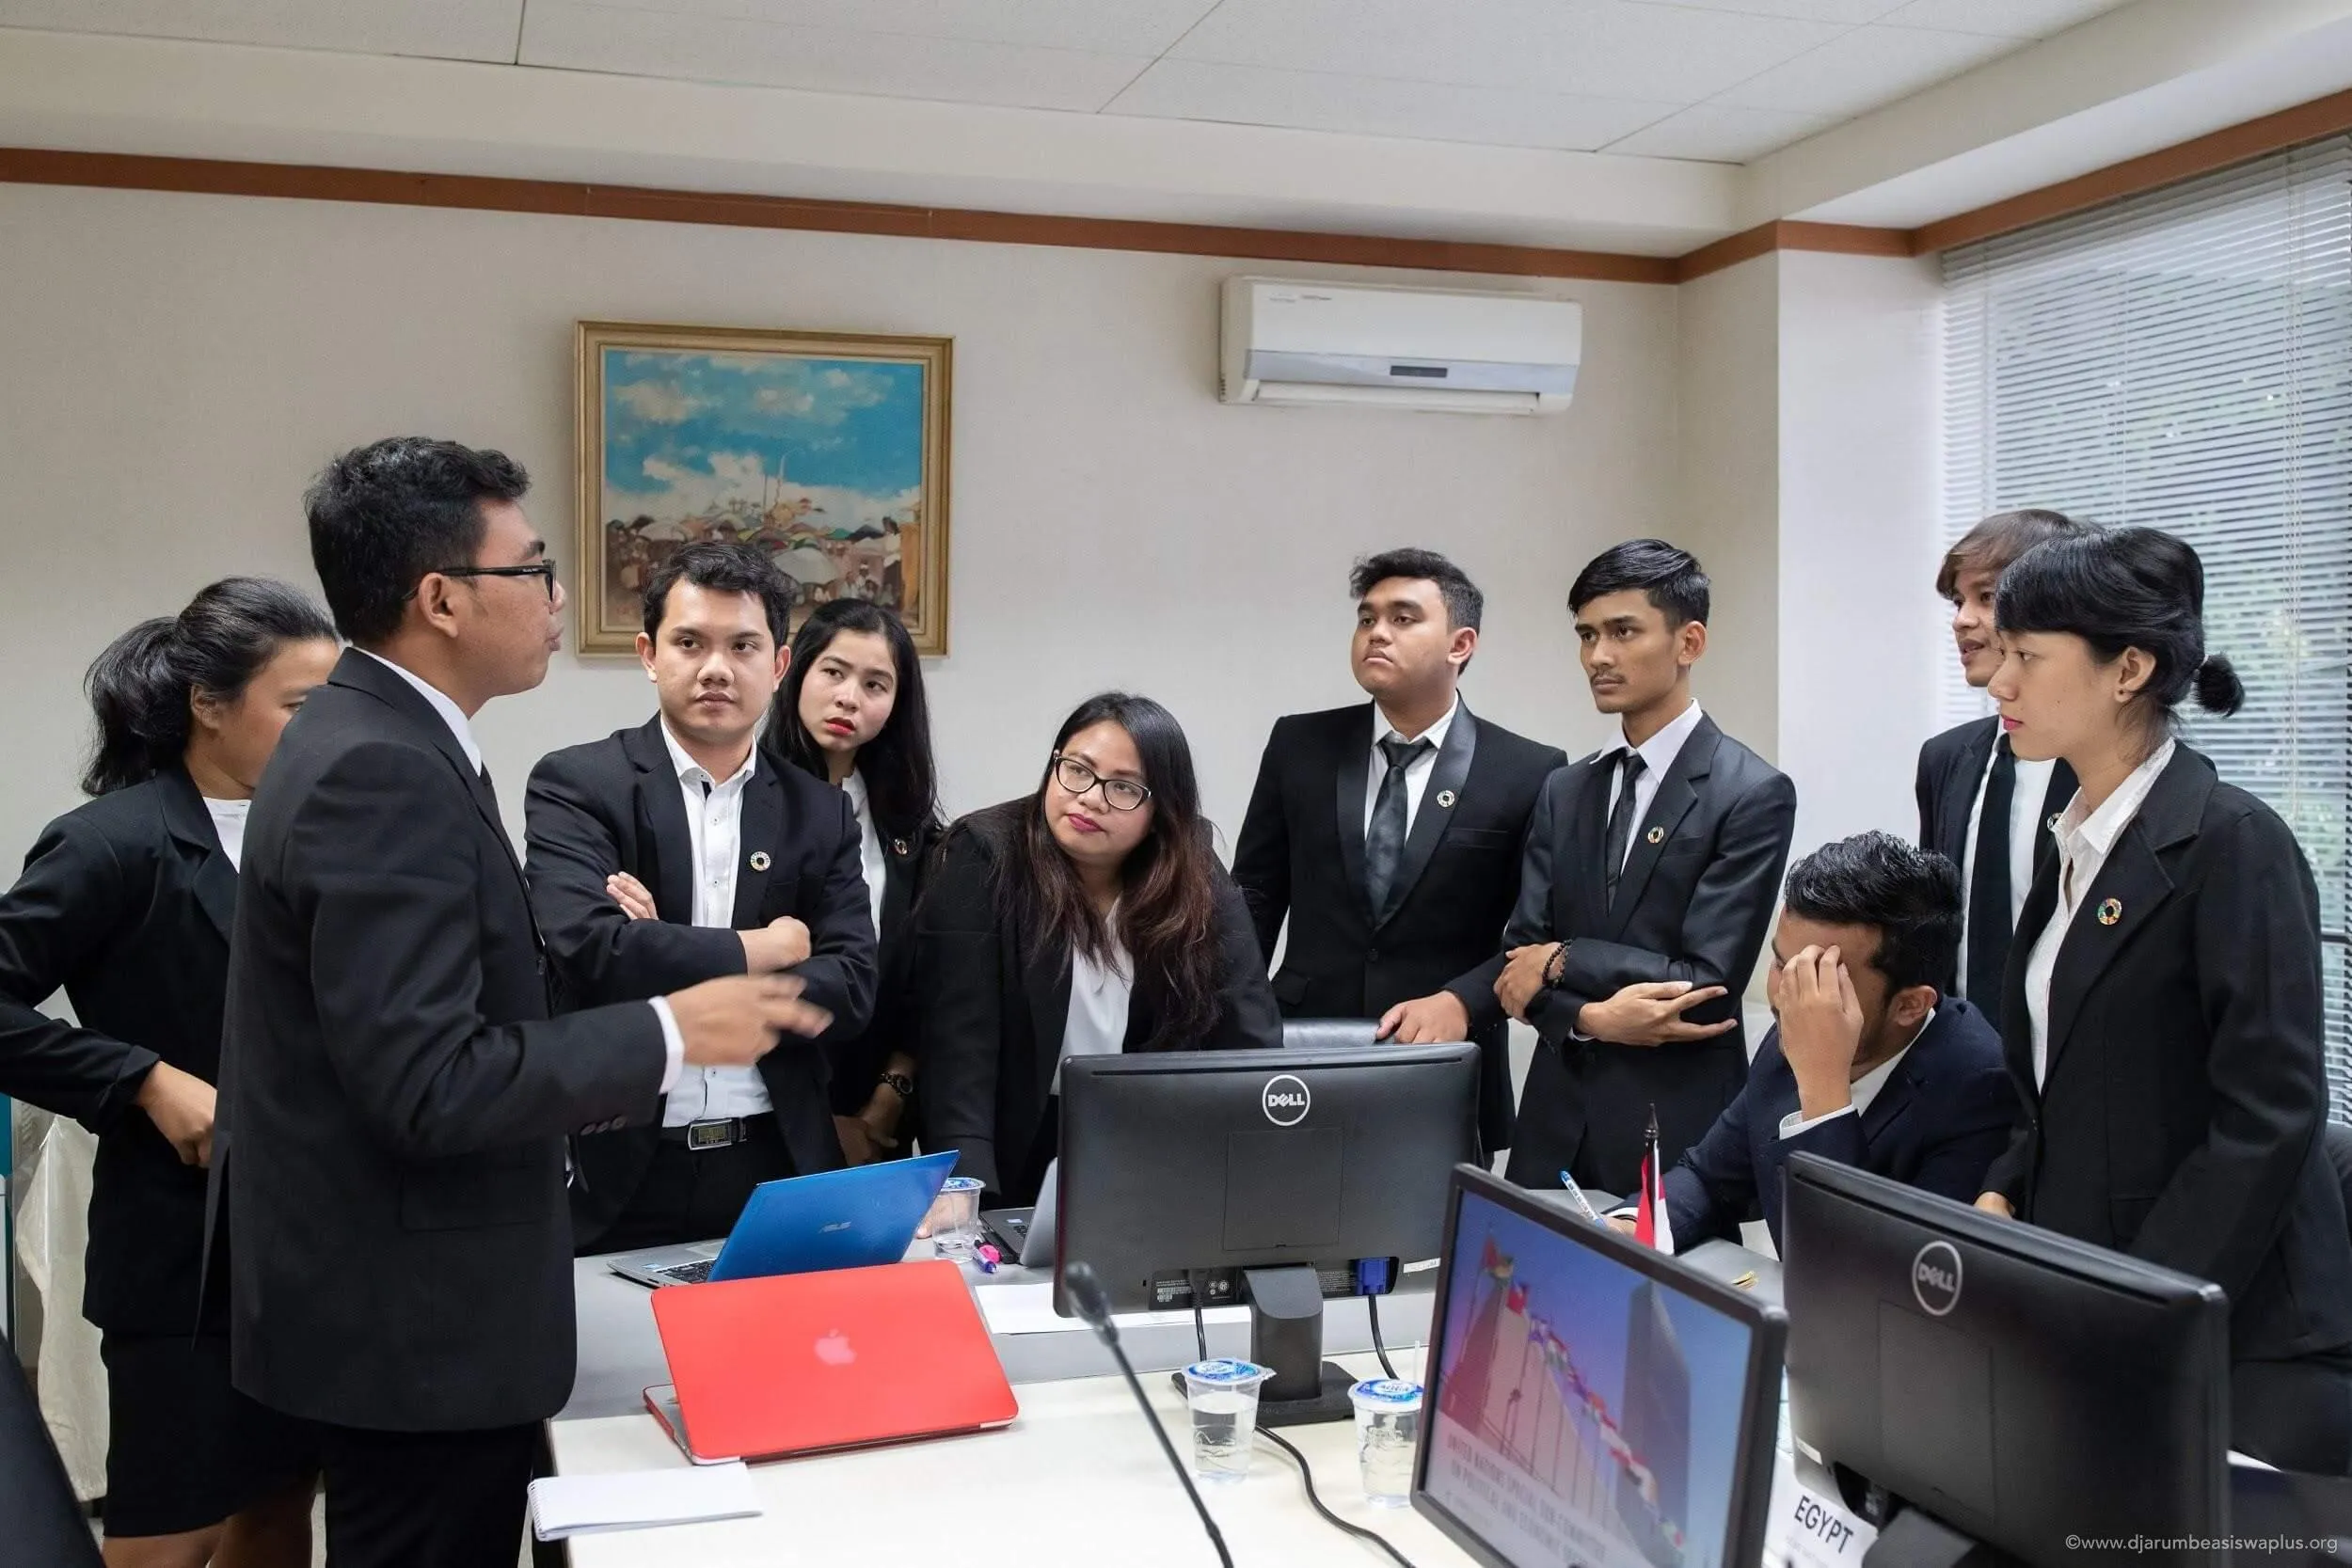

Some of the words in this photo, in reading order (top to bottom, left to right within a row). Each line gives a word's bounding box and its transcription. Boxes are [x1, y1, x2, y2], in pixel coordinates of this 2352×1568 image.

[1268, 1092, 1306, 1108] DELL
[1918, 1262, 1955, 1292] DELL
[1794, 1495, 1854, 1554] EGYPT
